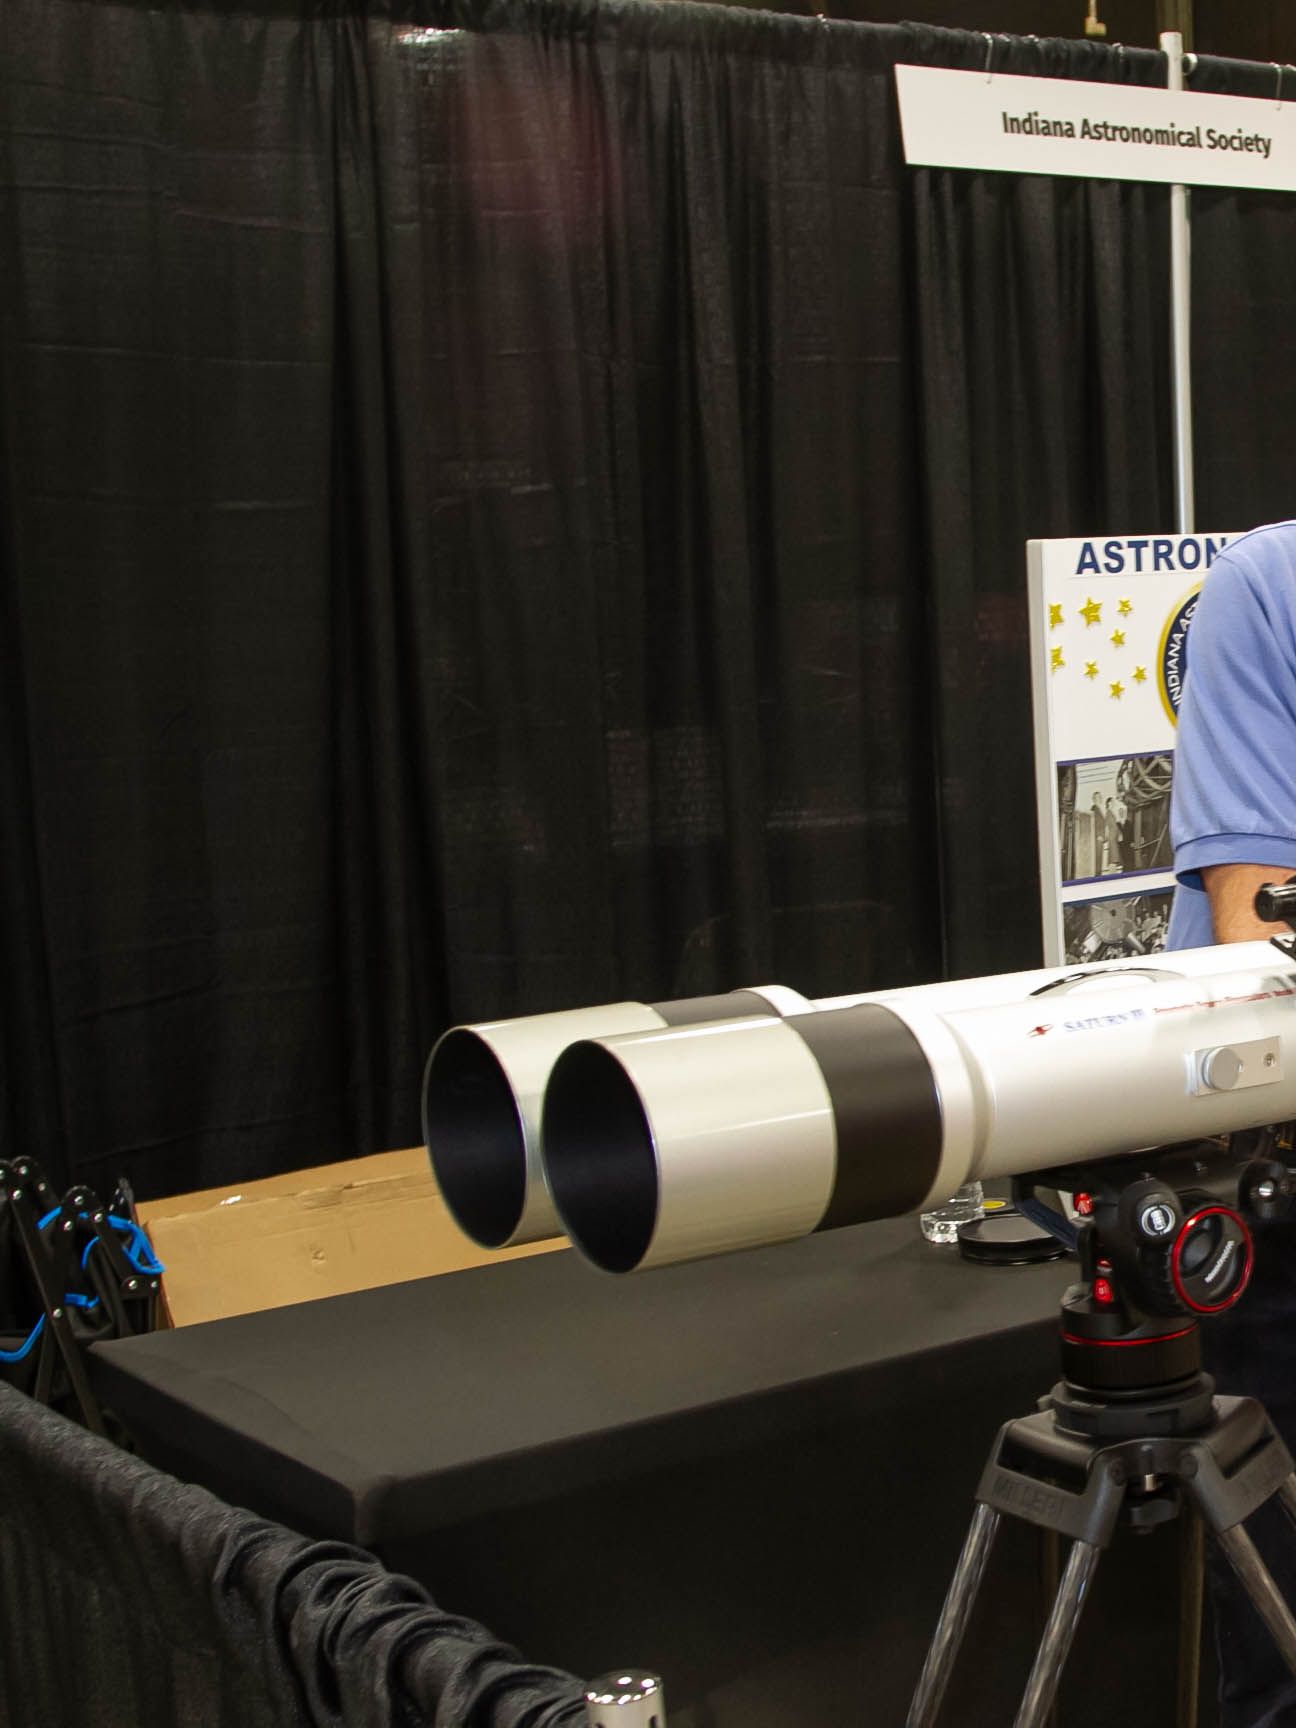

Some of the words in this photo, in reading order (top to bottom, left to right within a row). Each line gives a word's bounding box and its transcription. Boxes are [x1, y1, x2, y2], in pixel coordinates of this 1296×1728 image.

[1002, 111, 1075, 138] Indiana
[1080, 118, 1203, 148] Astronomical
[1206, 128, 1271, 158] Society
[1075, 537, 1227, 575] ASTRON
[1166, 633, 1185, 705] INDIANA
